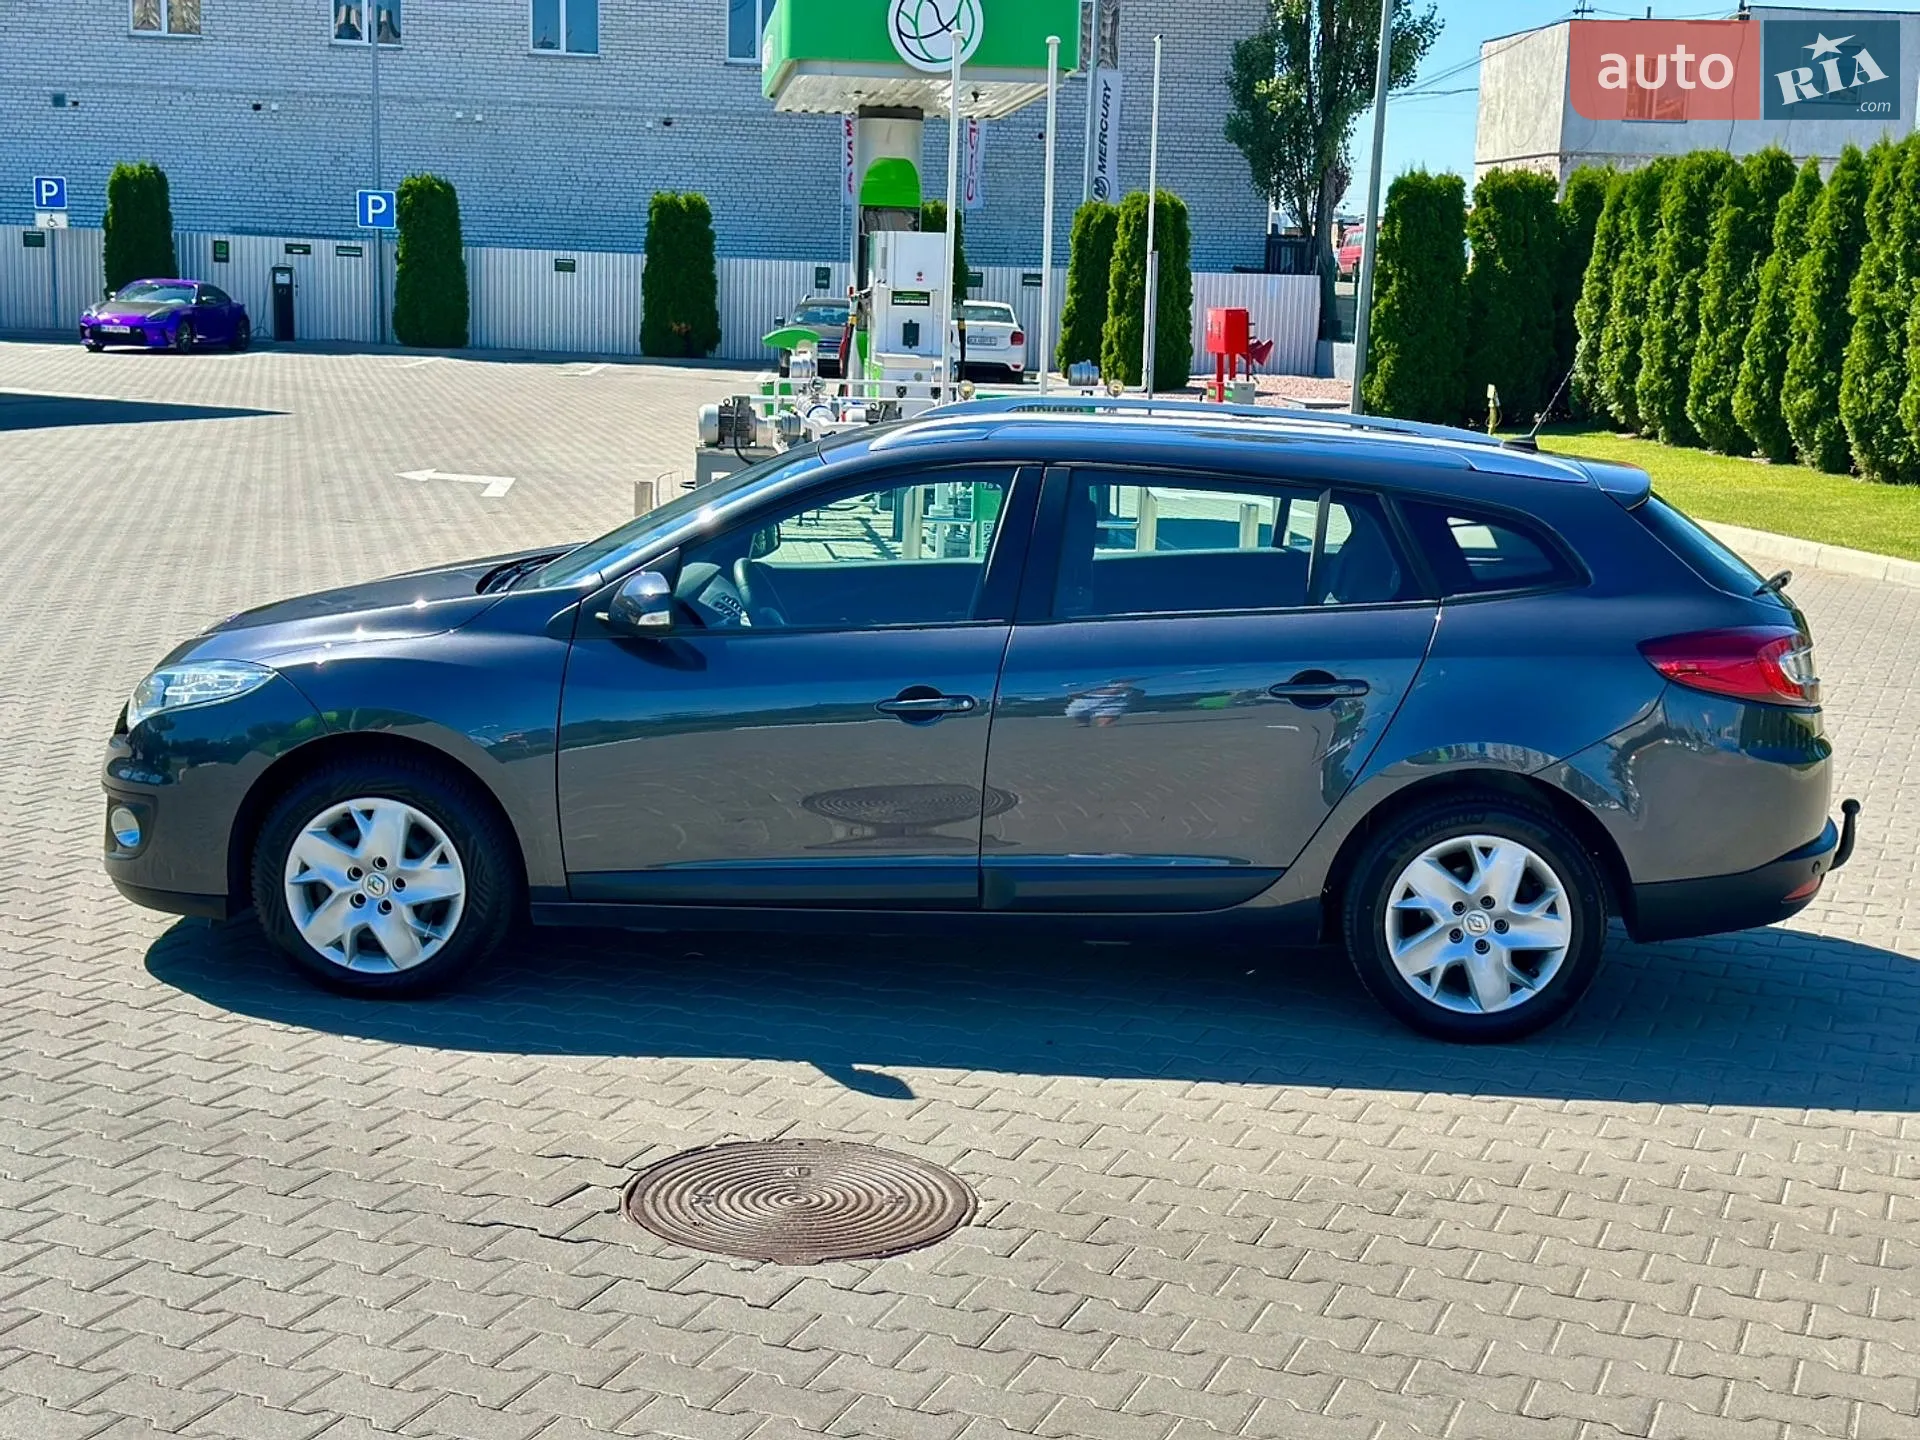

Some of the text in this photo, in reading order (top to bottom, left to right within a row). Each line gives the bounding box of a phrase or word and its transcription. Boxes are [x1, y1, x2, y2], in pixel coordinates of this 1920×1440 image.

[1097, 79, 1112, 174] MERCURY
[41, 180, 59, 205] P
[367, 195, 387, 223] P
